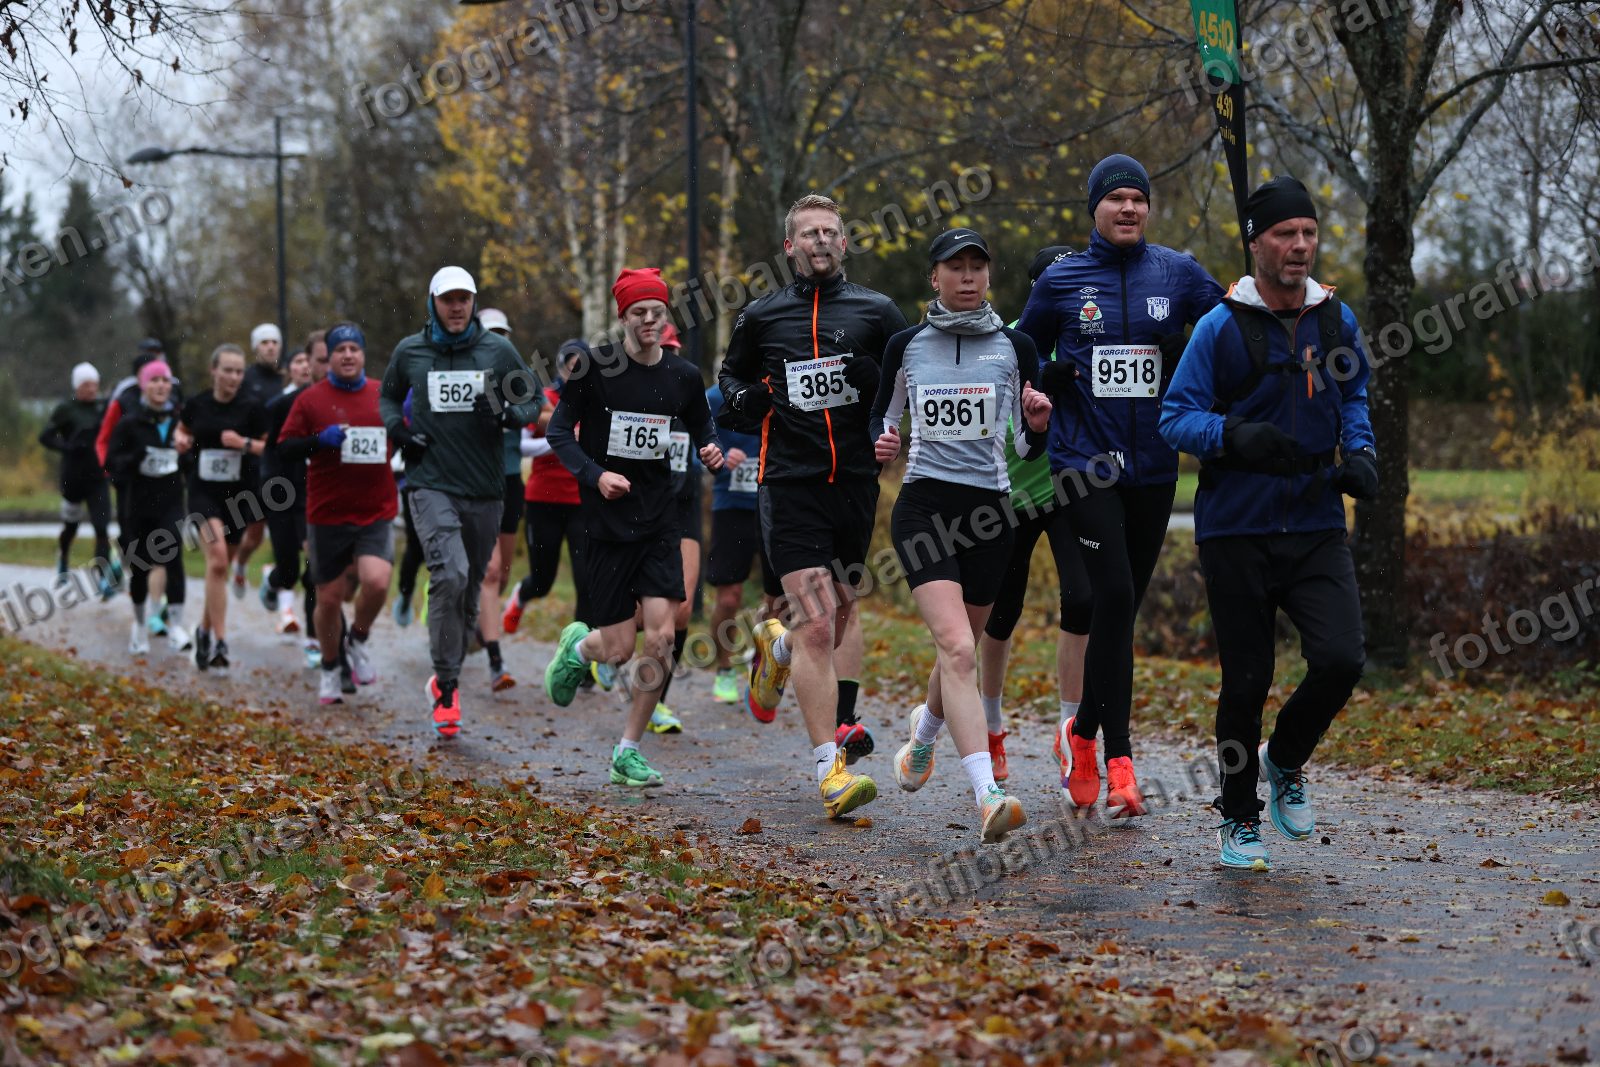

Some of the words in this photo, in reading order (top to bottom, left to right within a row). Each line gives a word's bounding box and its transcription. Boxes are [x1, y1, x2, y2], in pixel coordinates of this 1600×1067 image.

[1098, 348, 1158, 356] NORGESTESTEN
[791, 359, 847, 373] NORGESTESTE
[1098, 358, 1156, 384] 9518
[440, 383, 473, 403] 562
[800, 370, 844, 400] 385
[923, 387, 990, 396] NORGESTESTEN
[924, 398, 985, 427] 9361
[351, 438, 378, 455] 824
[624, 425, 659, 450] 165
[736, 466, 758, 483] 92
